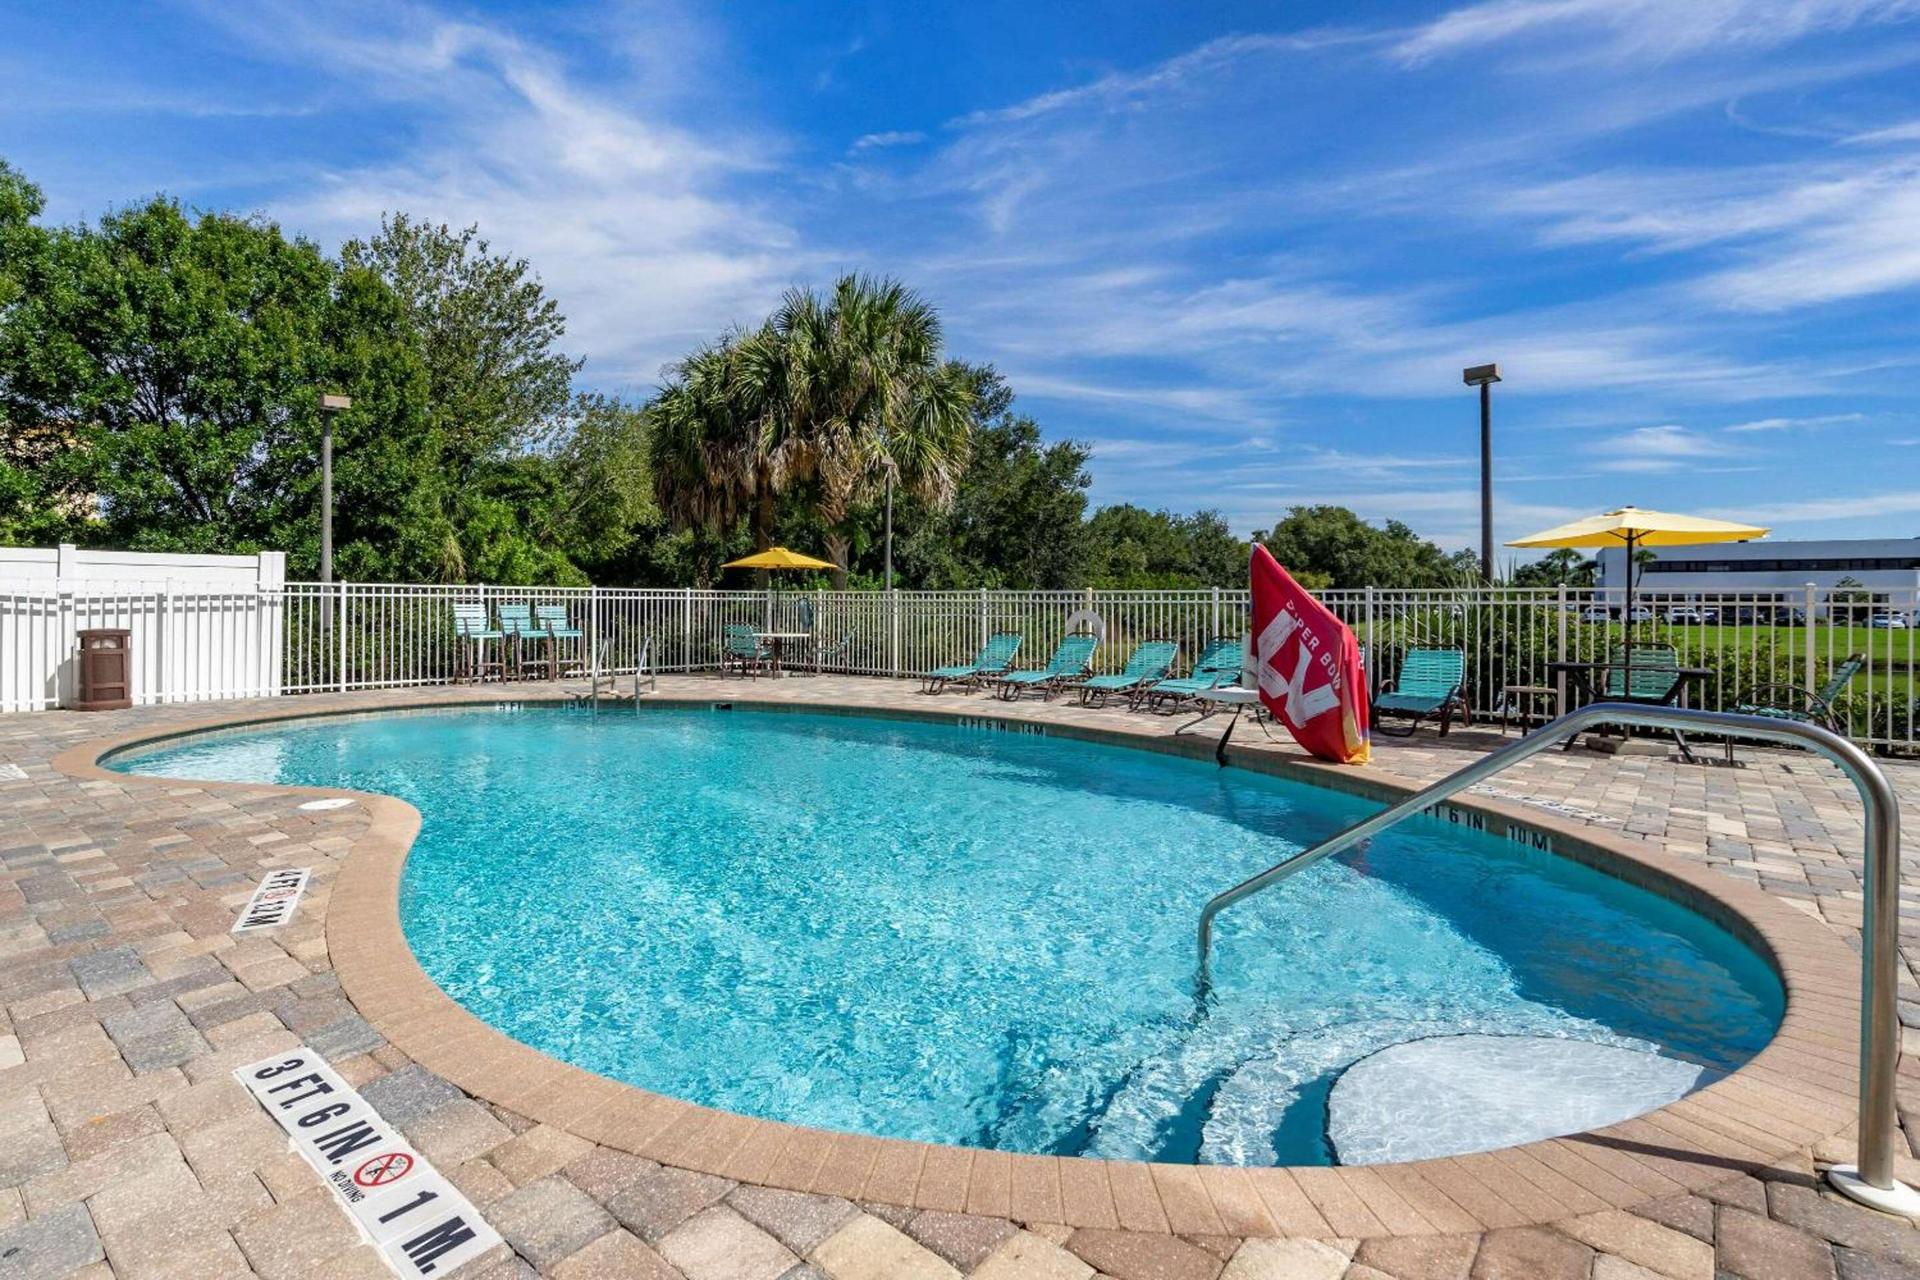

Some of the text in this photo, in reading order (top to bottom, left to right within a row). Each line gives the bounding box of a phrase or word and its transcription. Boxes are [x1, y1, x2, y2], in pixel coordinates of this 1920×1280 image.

[1285, 599, 1321, 651] PER
[997, 720, 1006, 732] IN
[1449, 808, 1459, 823] 6
[1467, 813, 1483, 830] IN
[1532, 832, 1547, 851] M
[254, 1058, 305, 1080] 3
[297, 1102, 351, 1128] 6
[377, 1189, 439, 1225] 1
